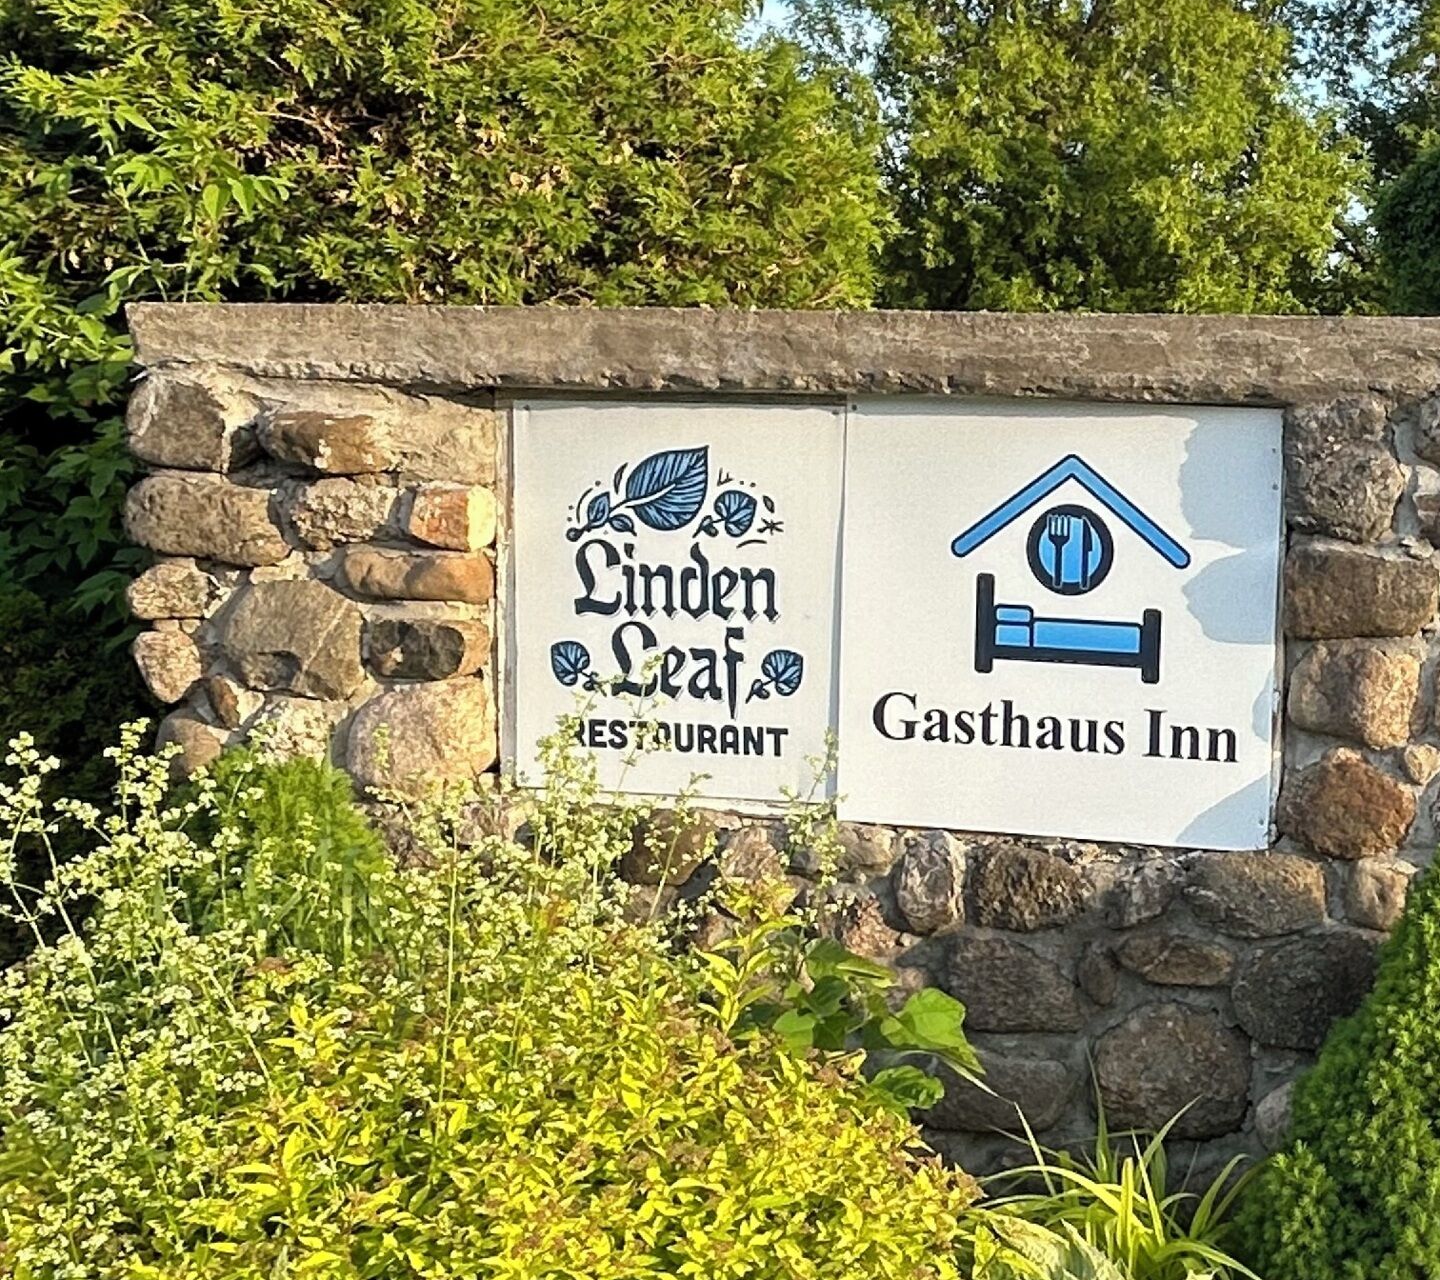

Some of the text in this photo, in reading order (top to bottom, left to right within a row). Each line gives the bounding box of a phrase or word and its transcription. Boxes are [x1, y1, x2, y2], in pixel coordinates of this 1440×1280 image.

[574, 539, 780, 621] Linden
[611, 621, 745, 720] Leaf
[872, 691, 1240, 764] Gasthaus Inn
